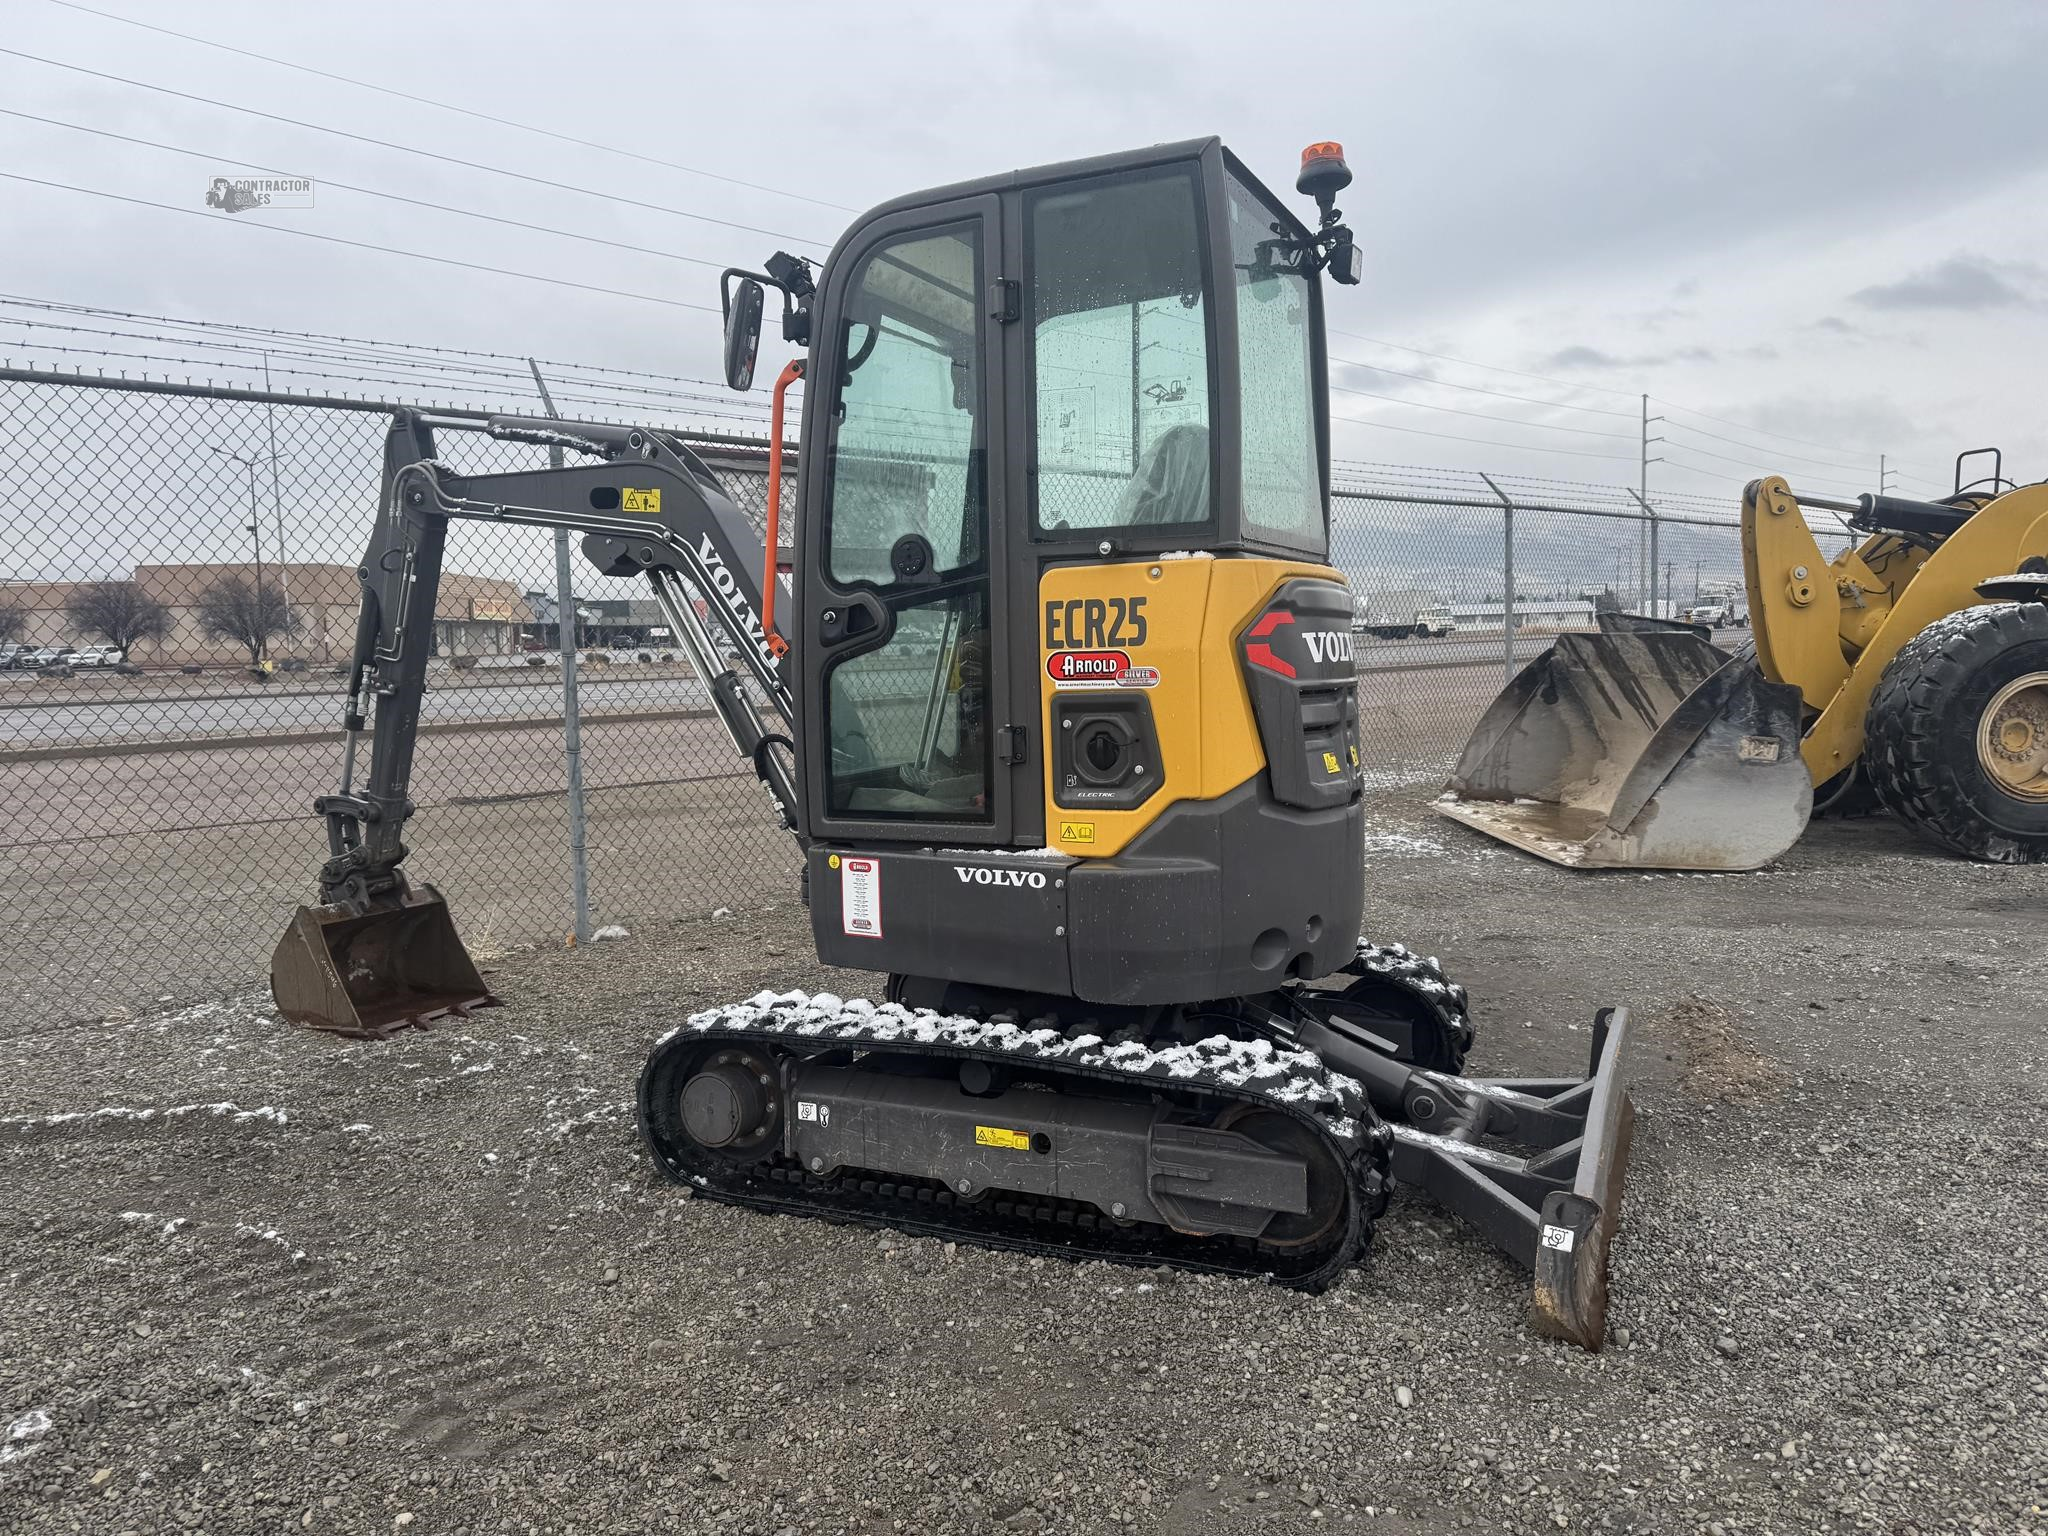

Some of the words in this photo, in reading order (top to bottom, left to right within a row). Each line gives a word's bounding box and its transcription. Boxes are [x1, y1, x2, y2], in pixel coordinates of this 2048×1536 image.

[1045, 596, 1147, 649] ECR25
[1124, 670, 1150, 678] SILVER
[954, 866, 1047, 889] VOLVO
